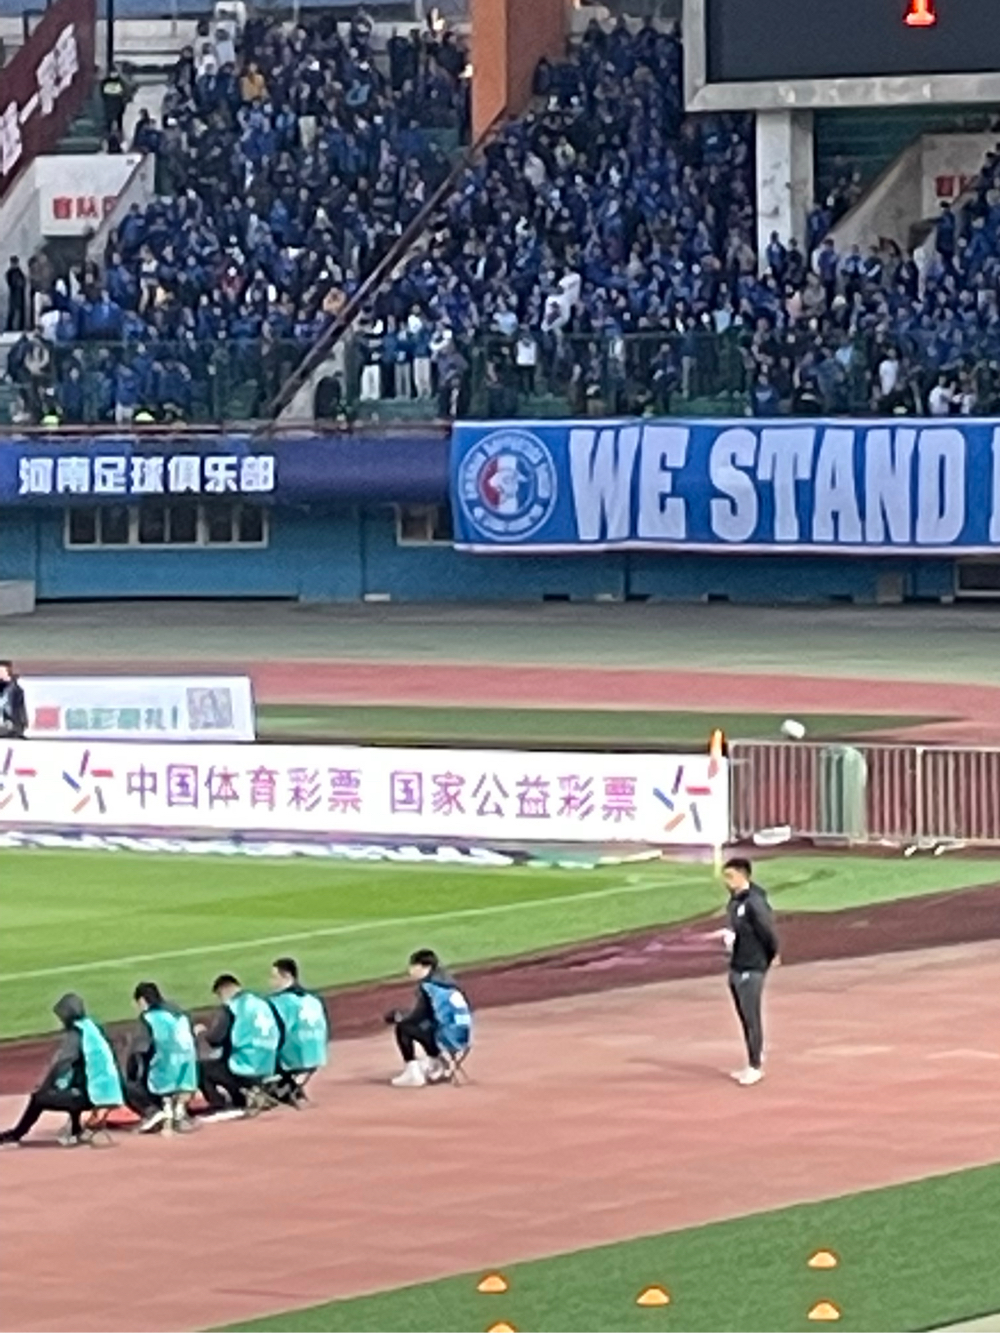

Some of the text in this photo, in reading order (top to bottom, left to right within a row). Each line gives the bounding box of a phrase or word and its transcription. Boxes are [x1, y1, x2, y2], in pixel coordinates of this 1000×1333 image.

[18, 455, 276, 494] 河南足球俱乐部
[568, 425, 690, 541] WE
[709, 426, 967, 543] STAND
[126, 763, 639, 823] 中国体育彩票 国家公益彩票
